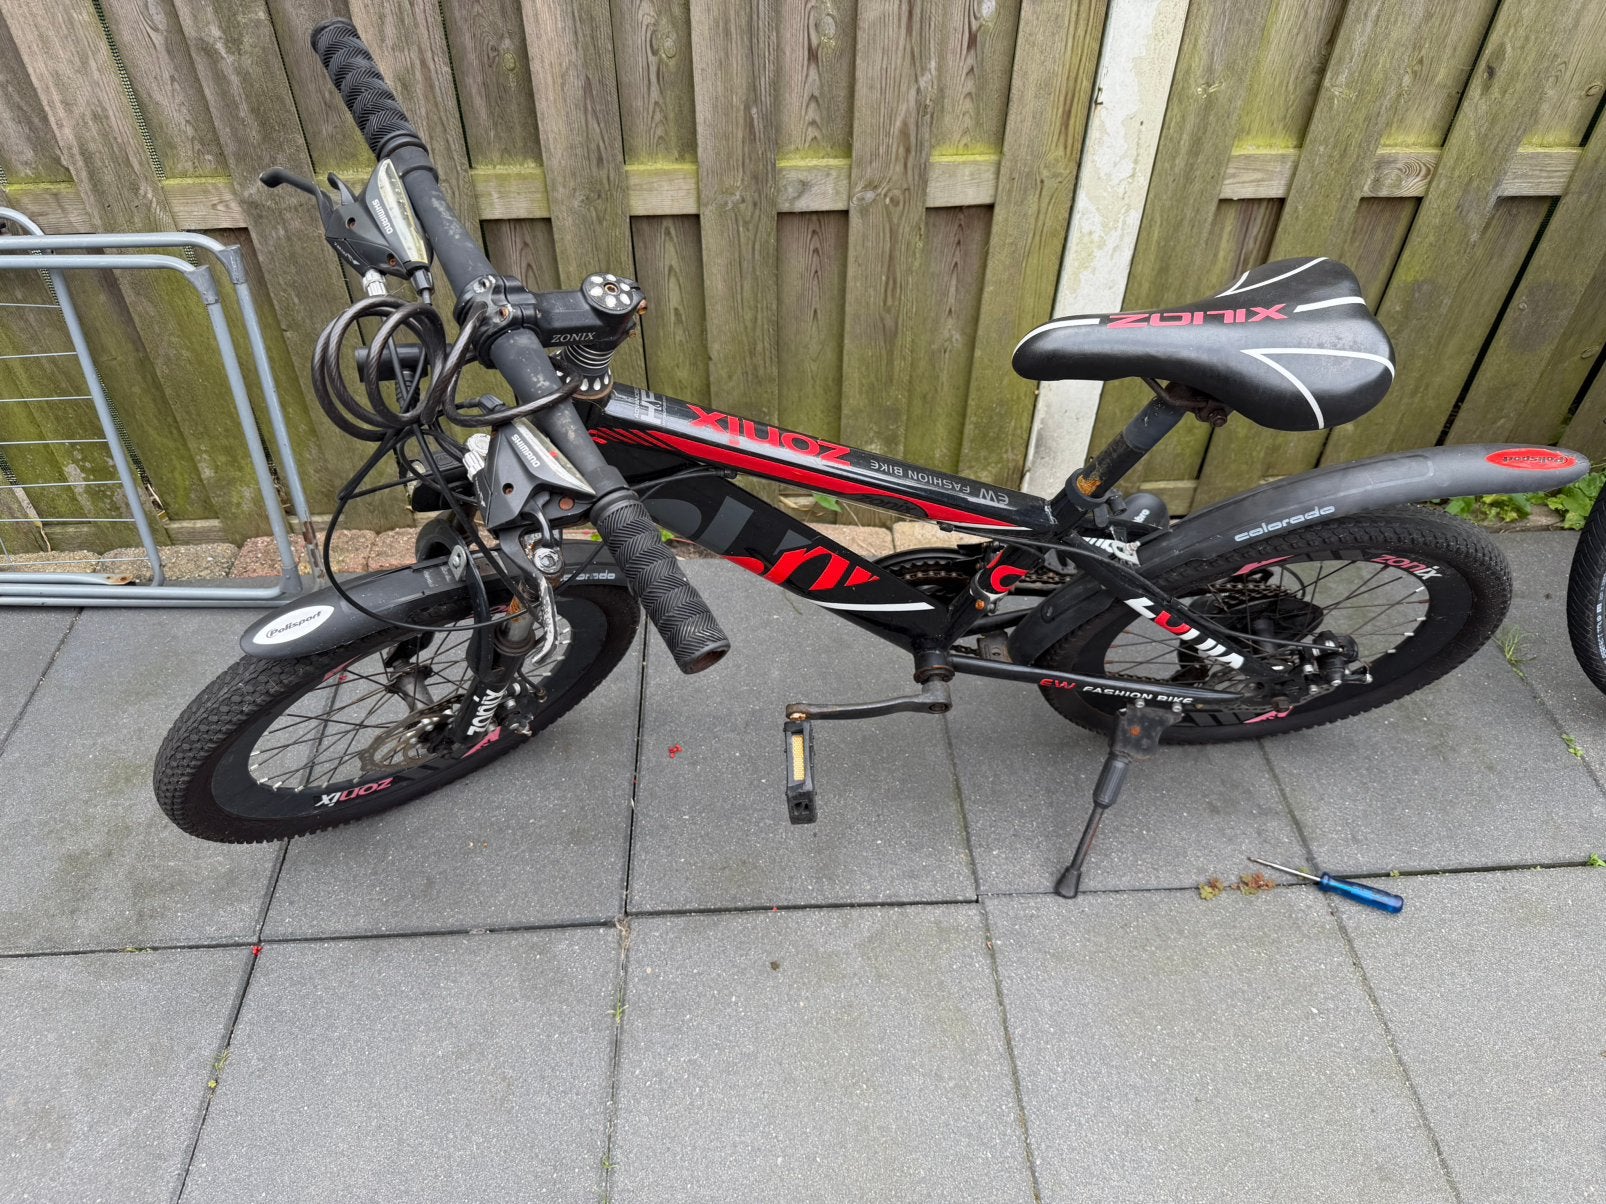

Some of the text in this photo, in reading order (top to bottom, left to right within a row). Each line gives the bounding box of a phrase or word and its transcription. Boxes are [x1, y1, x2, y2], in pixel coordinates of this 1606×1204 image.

[550, 331, 597, 344] ZONIX
[510, 433, 541, 468] SHIMANO
[686, 403, 853, 468] zonix
[870, 458, 1009, 505] EW FASHION BIKE
[1233, 504, 1337, 543] colorado
[1370, 554, 1443, 580] zonix
[264, 610, 324, 639] Polisport
[1039, 678, 1194, 704] EW FASHION BIKE
[314, 777, 394, 807] zonix
